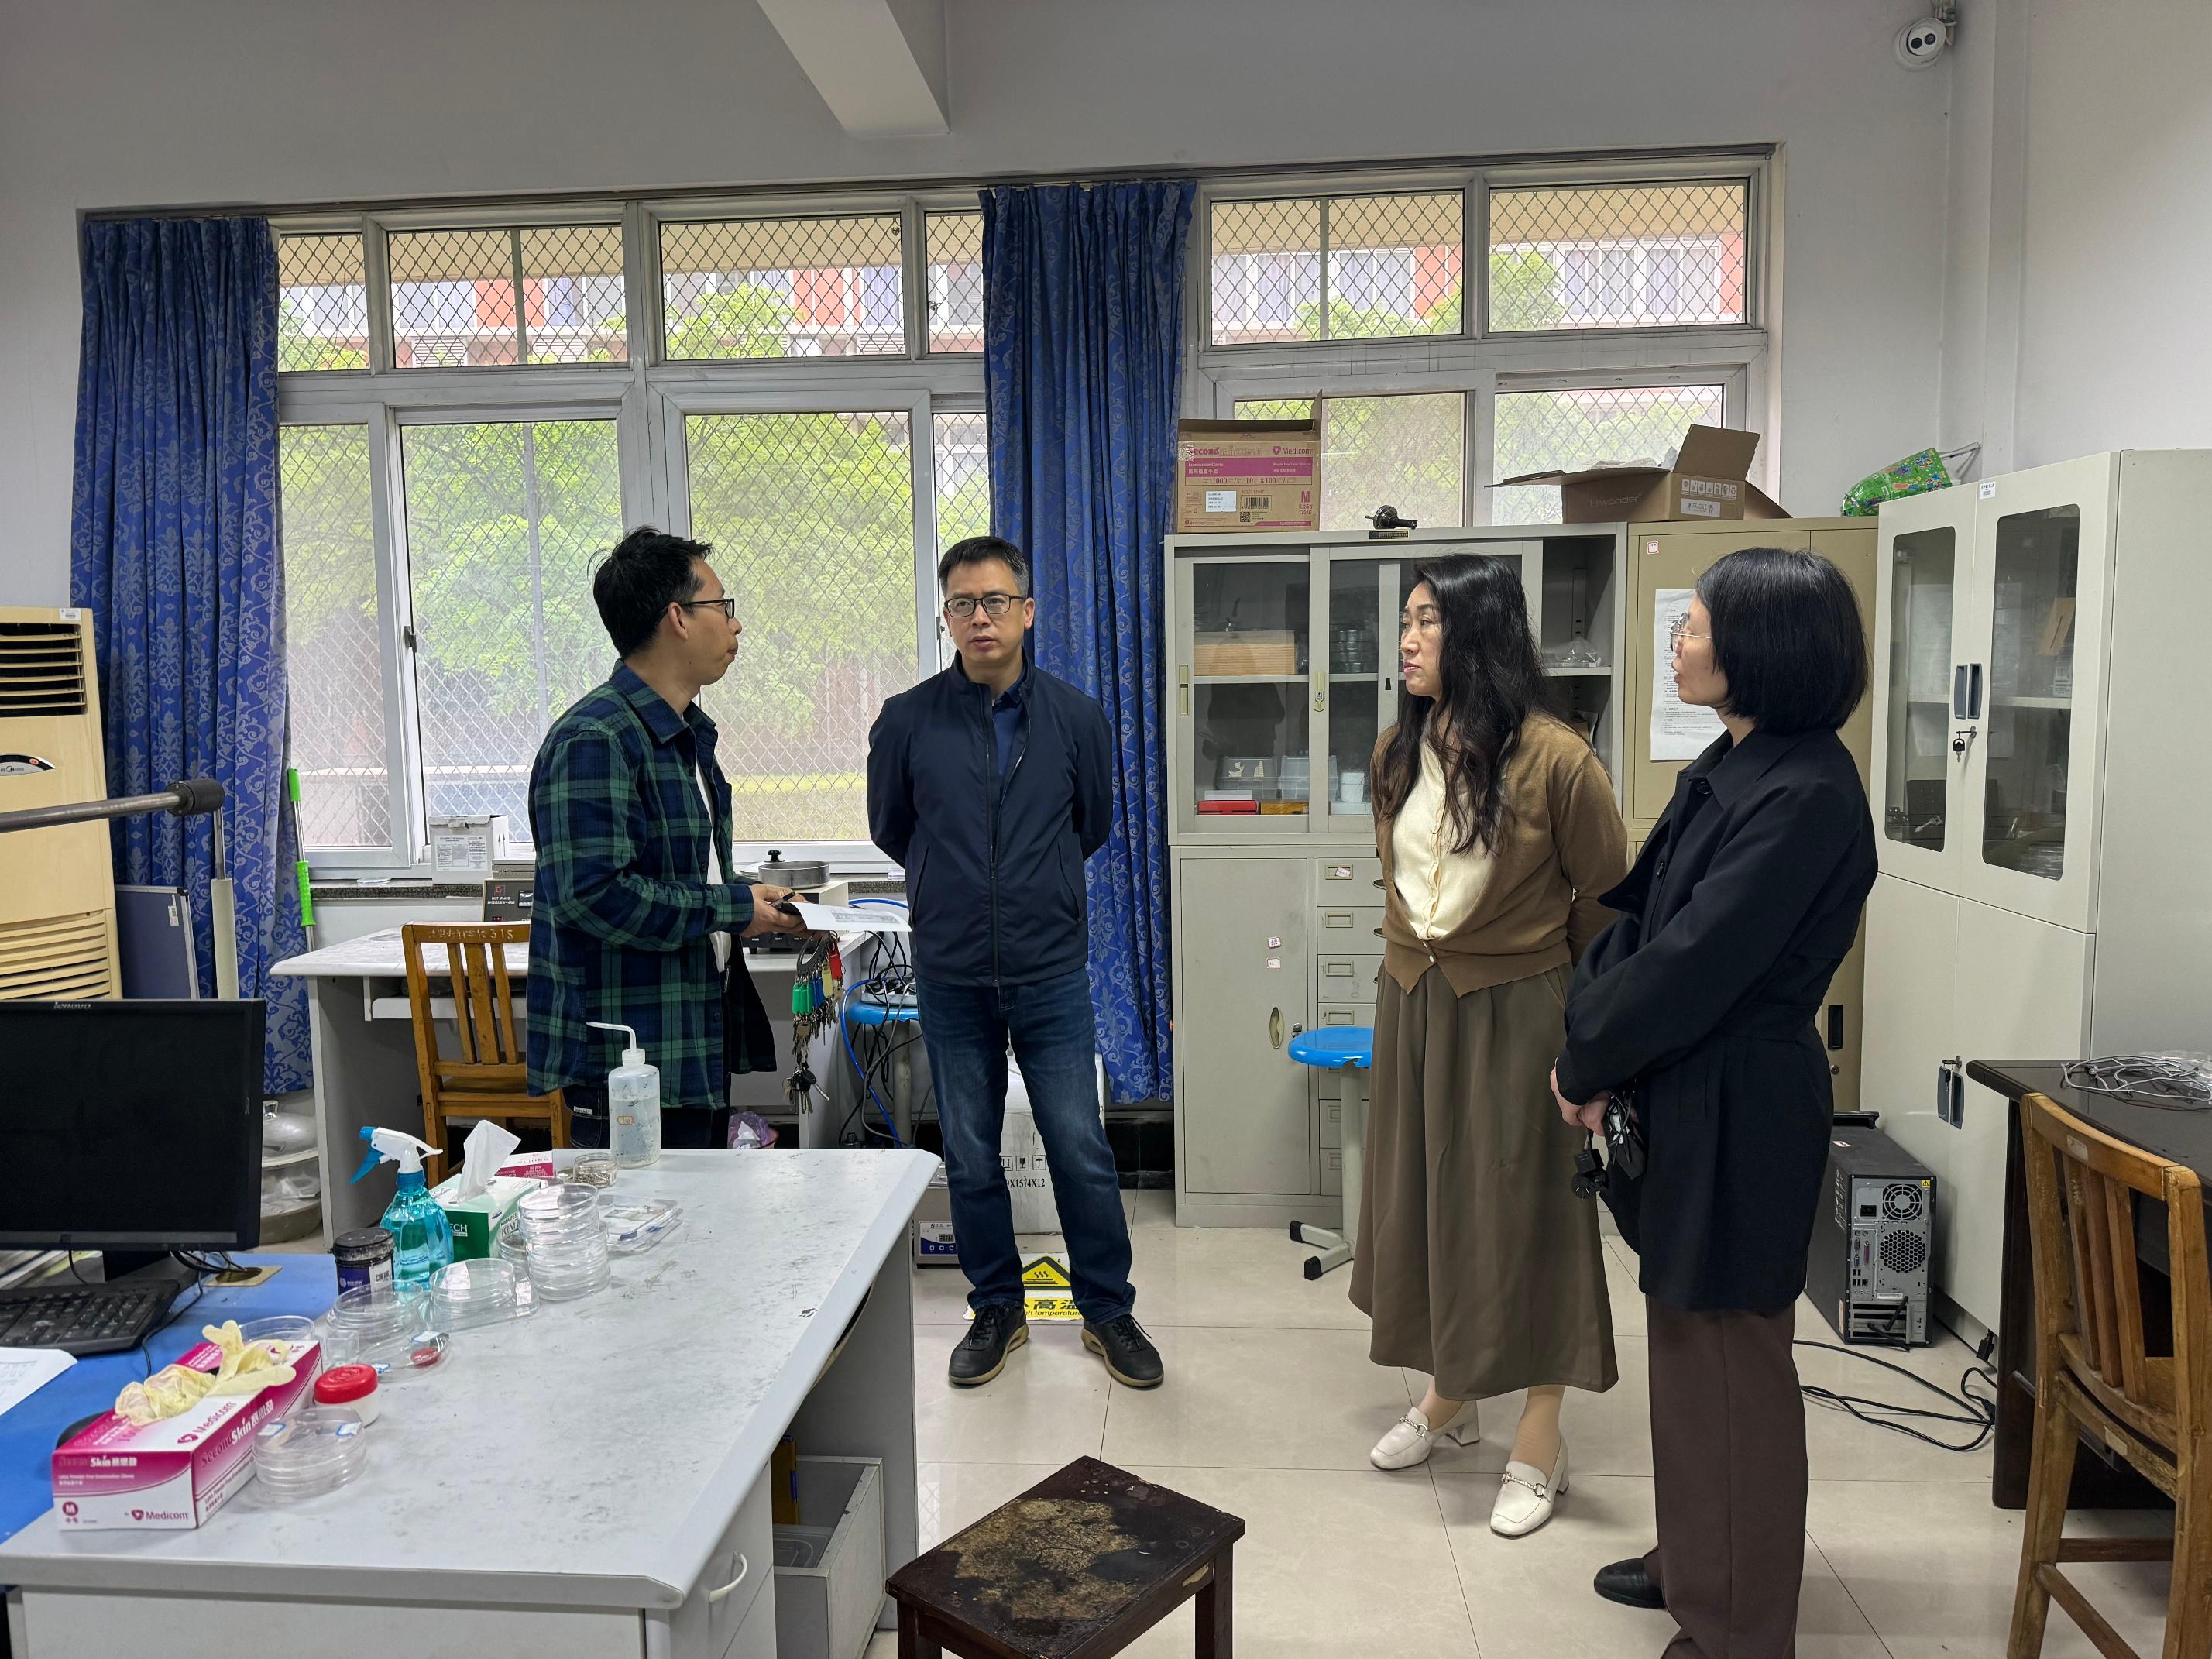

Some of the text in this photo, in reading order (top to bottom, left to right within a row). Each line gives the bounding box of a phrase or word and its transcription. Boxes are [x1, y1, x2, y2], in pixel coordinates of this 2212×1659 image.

[1301, 490, 1310, 503] M
[192, 1401, 237, 1433] Medicom
[90, 1455, 112, 1467] Skin
[146, 1510, 189, 1520] Medicom
